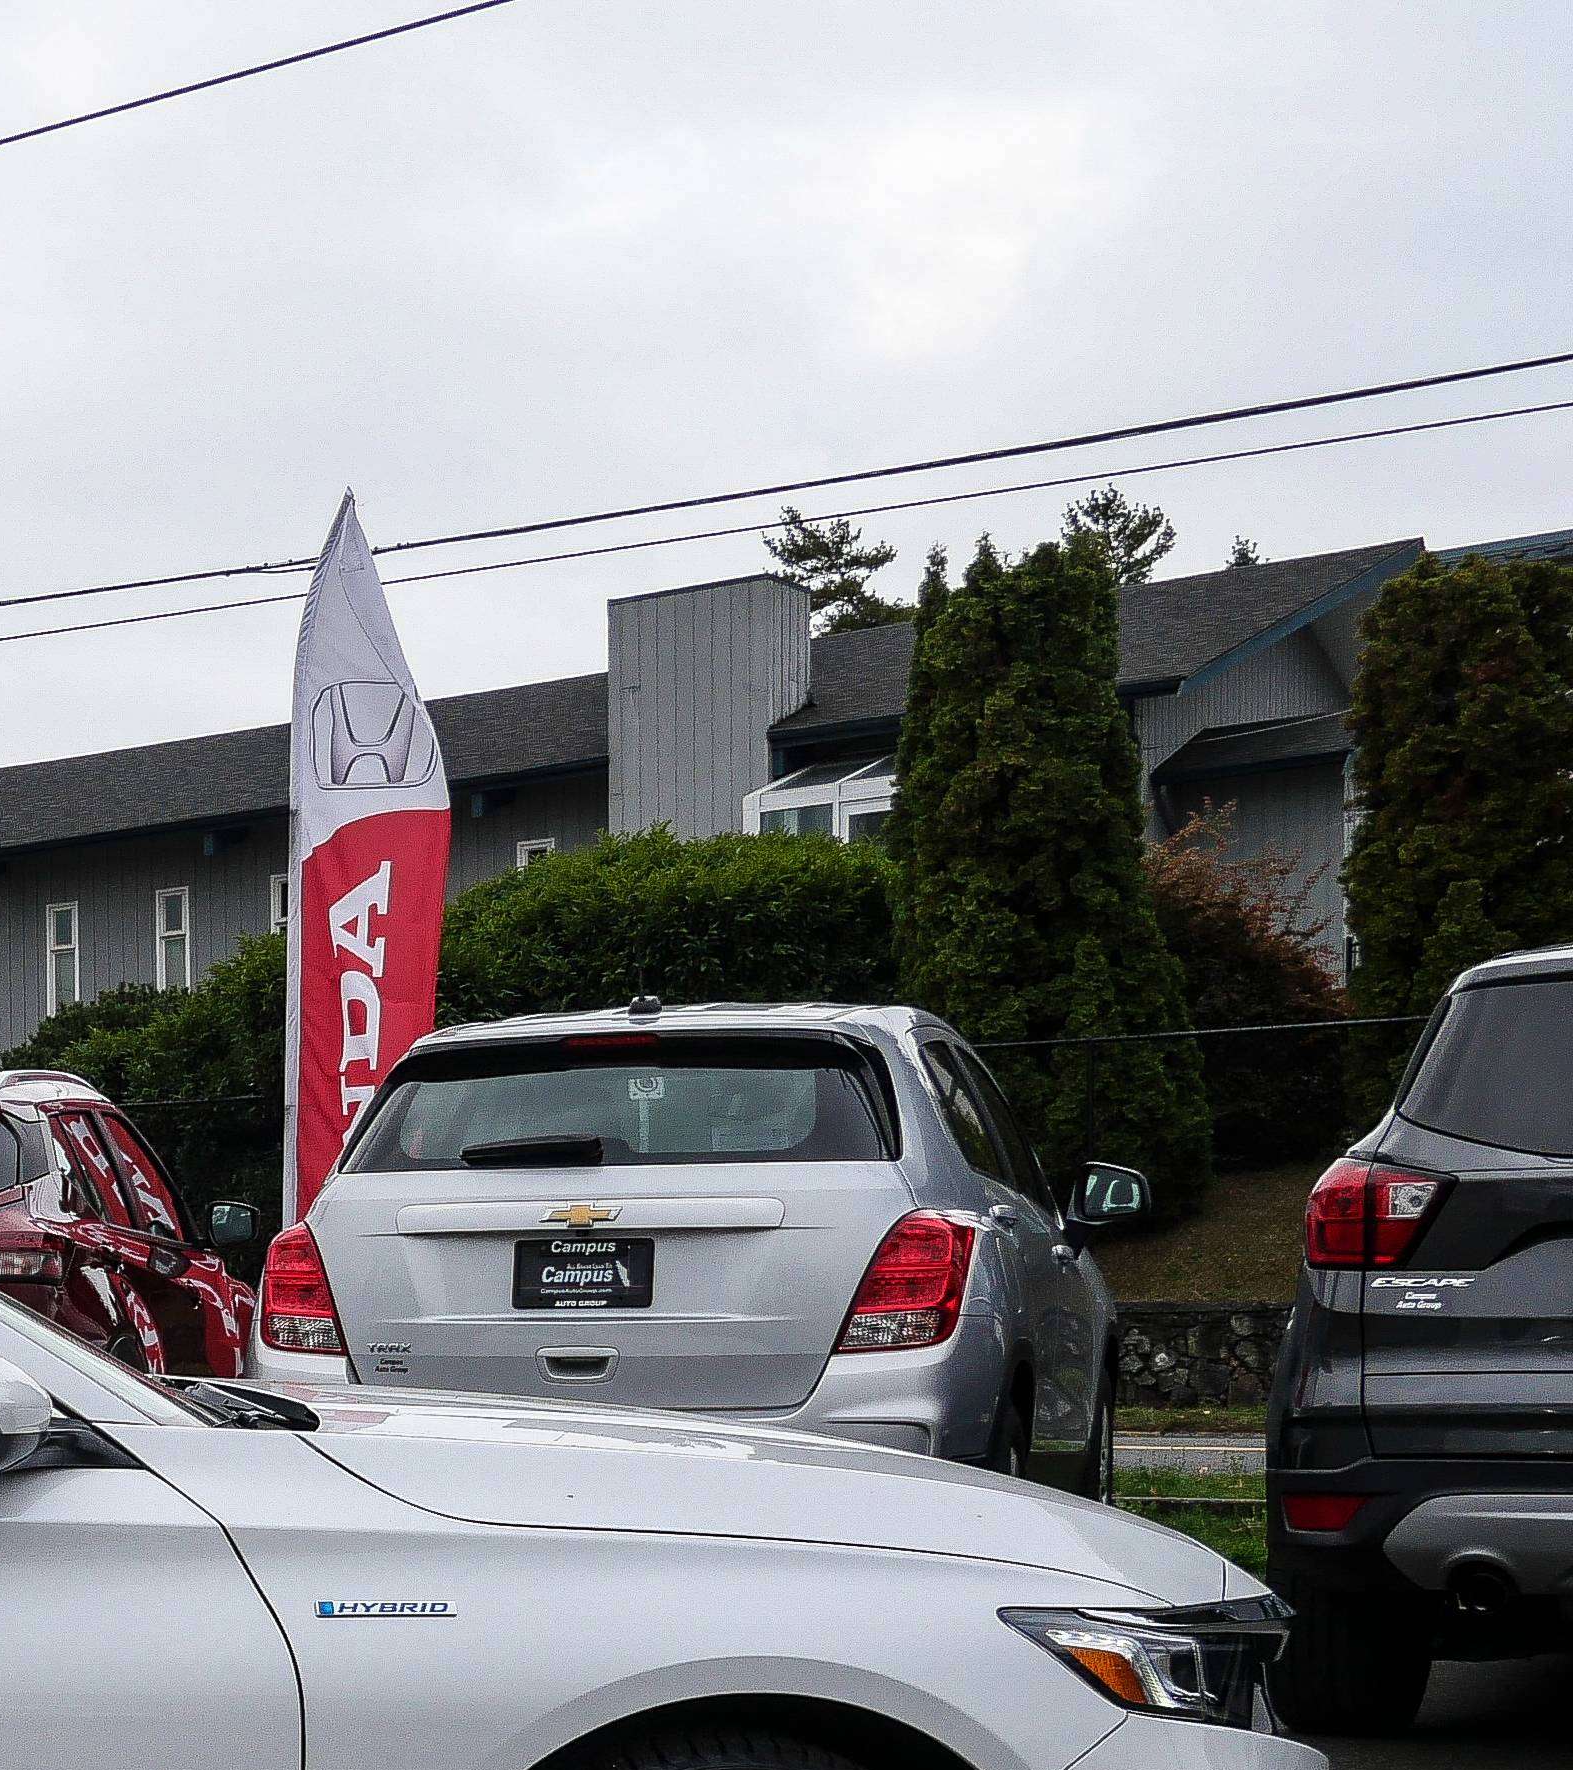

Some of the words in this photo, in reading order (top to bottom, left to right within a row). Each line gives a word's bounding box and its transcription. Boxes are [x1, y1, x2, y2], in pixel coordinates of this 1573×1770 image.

[551, 1240, 616, 1255] Campus
[541, 1266, 614, 1286] Campus
[1371, 1277, 1475, 1288] ESCAPE
[366, 1342, 412, 1353] TRAX
[338, 1602, 449, 1613] HYBRID
